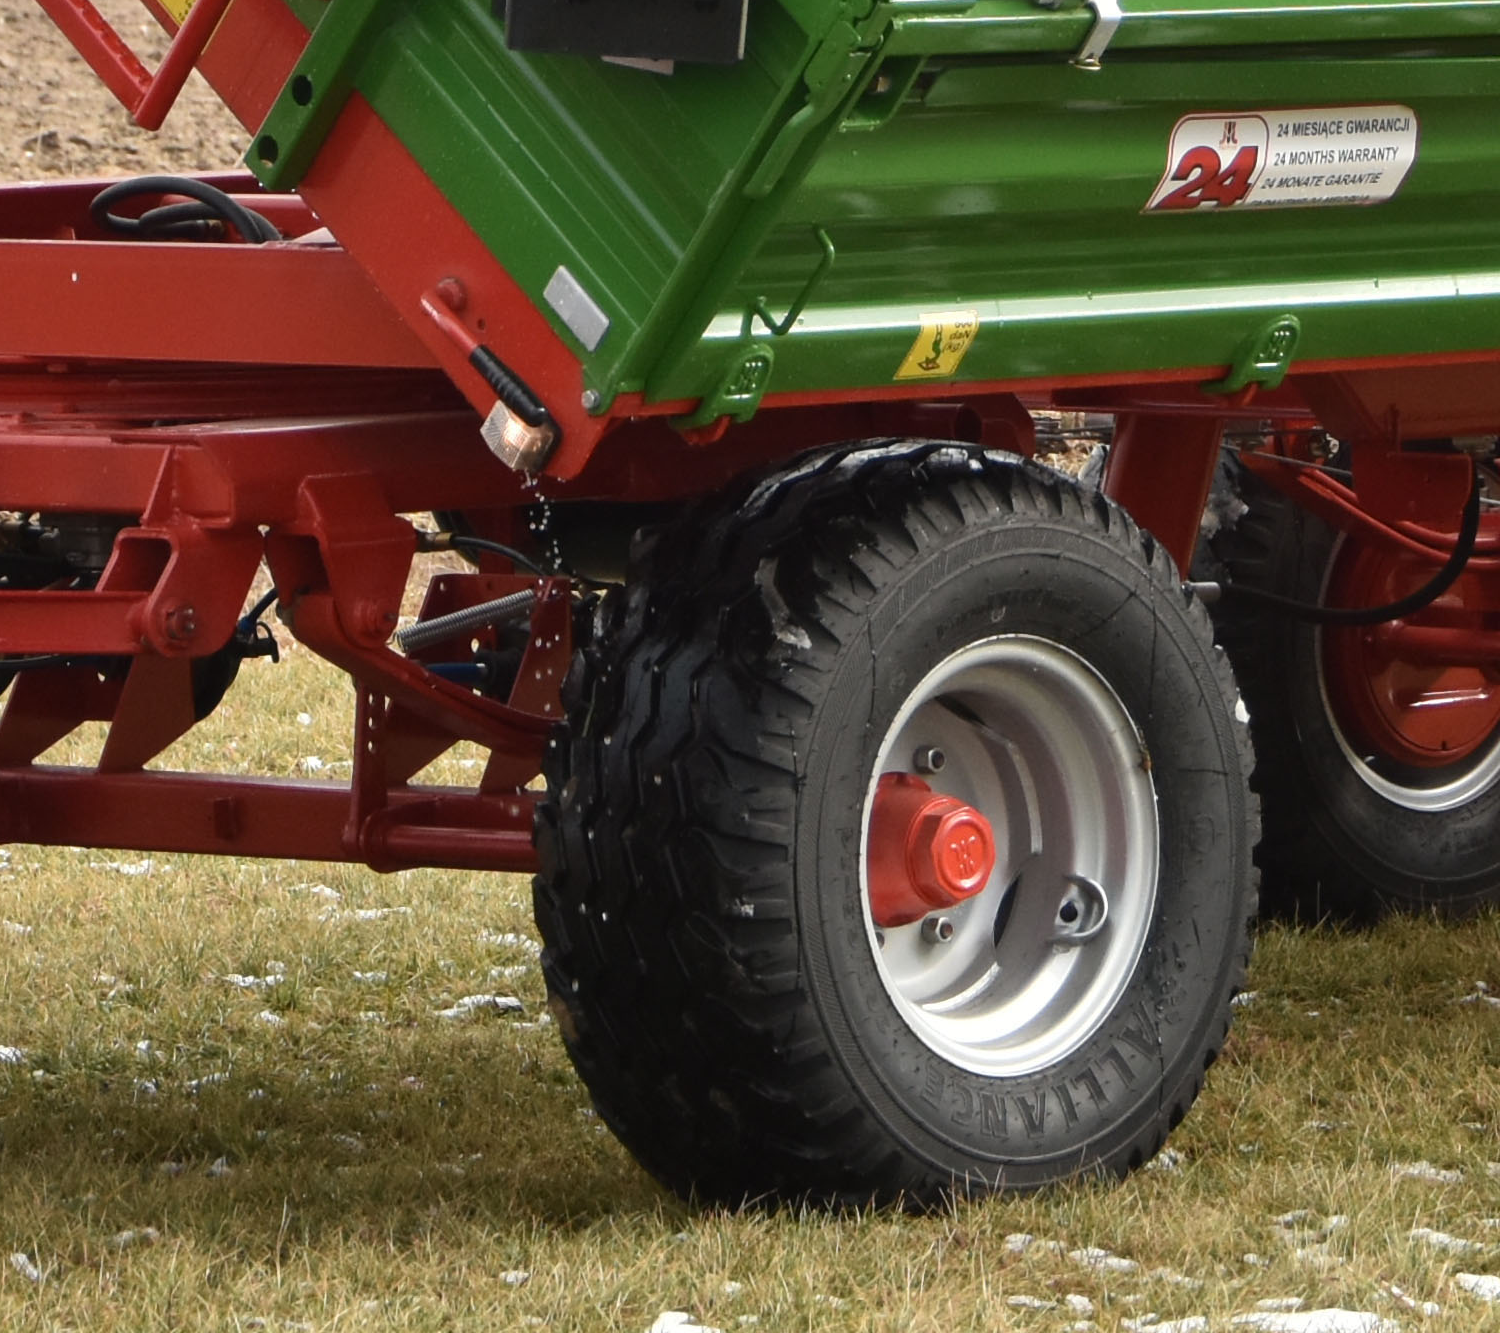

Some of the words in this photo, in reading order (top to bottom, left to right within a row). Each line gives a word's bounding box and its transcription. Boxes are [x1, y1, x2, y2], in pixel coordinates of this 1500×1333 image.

[1277, 123, 1290, 138] 24
[1292, 120, 1343, 140] MIESIĄCE
[1346, 117, 1411, 134] GWARANCJI
[1274, 152, 1287, 166] 24
[1289, 149, 1335, 166] MONTHS
[1338, 146, 1400, 164] WARRANTY
[1151, 145, 1259, 211] 24
[1260, 178, 1275, 190] 24
[1276, 175, 1325, 189] MONATE
[1325, 172, 1383, 187] GARANTIE
[919, 1000, 1159, 1139] ALLIANCE
